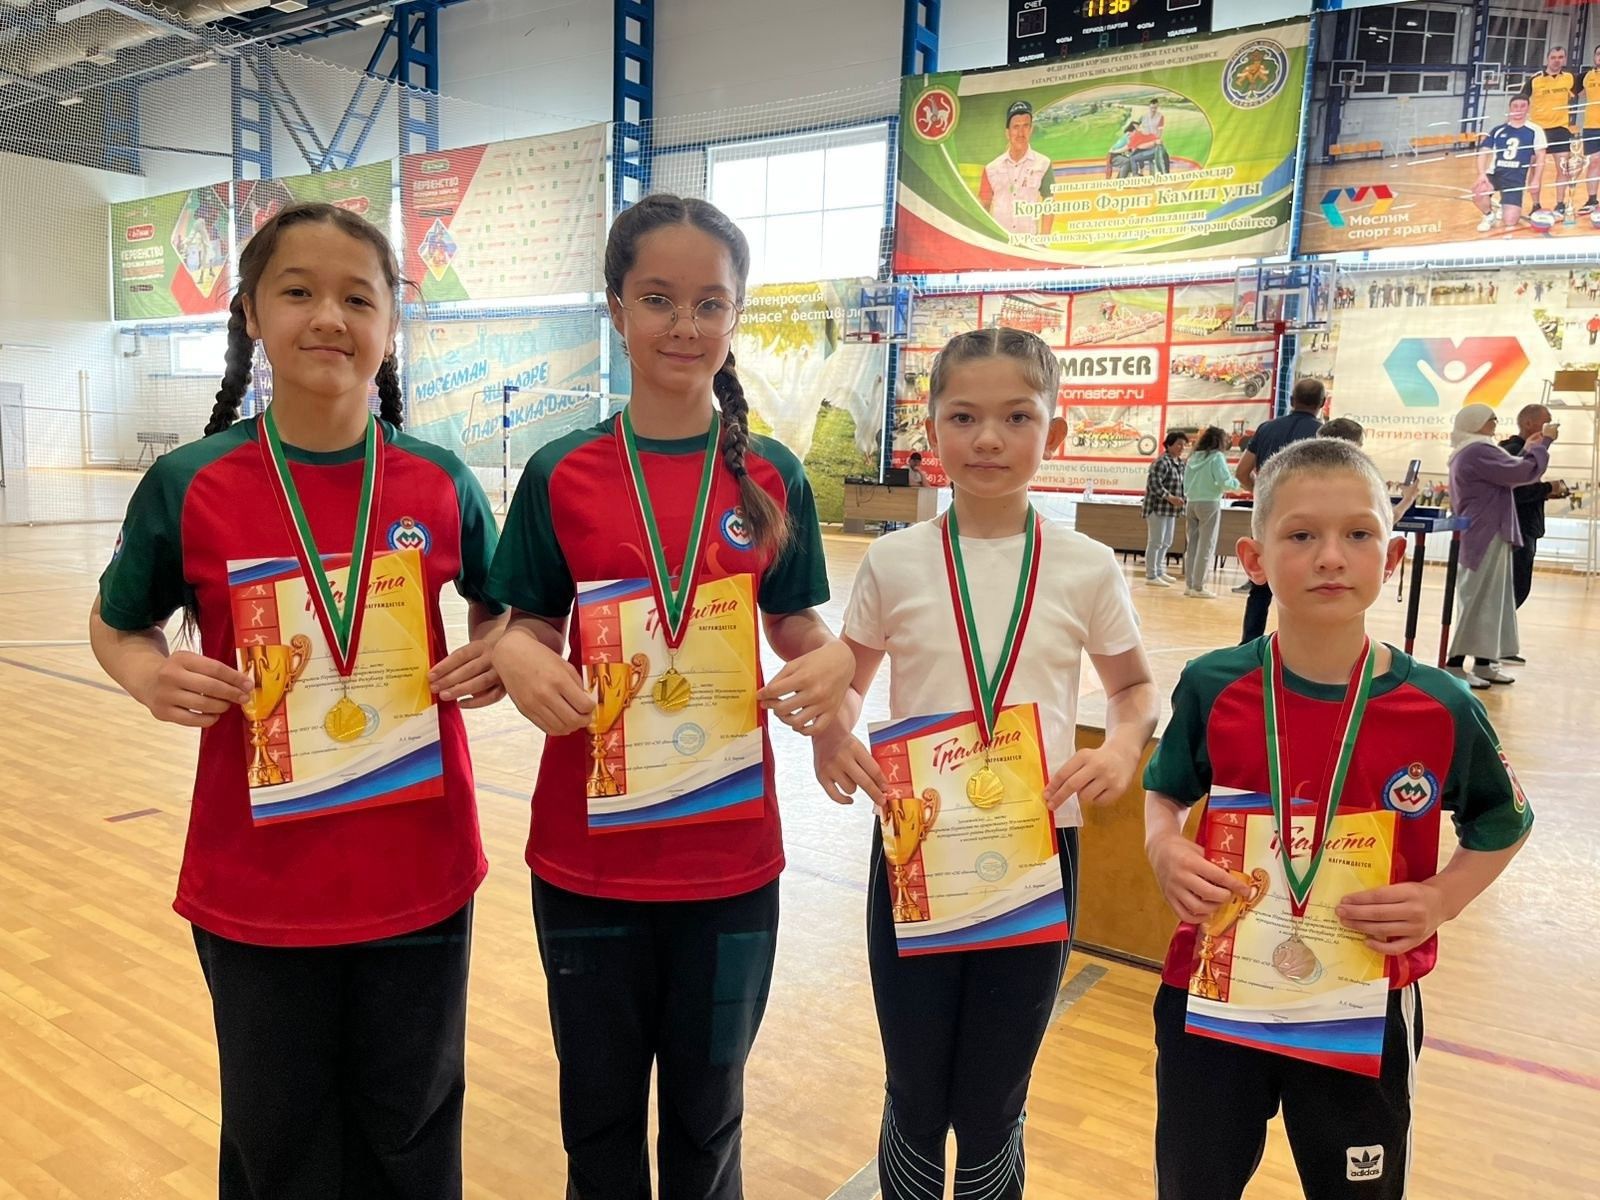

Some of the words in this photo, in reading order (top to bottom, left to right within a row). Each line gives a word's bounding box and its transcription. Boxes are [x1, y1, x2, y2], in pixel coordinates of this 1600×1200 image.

[1014, 198, 1091, 217] Корбанов
[1157, 188, 1218, 205] Камил
[1221, 183, 1261, 202] улы
[1348, 226, 1391, 240] спорт
[1393, 221, 1442, 238] ярата!
[1060, 355, 1152, 376] MASTER
[1058, 388, 1145, 400] romaster.ru
[1067, 477, 1119, 486] здоовья
[1350, 1168, 1380, 1177] adidas
